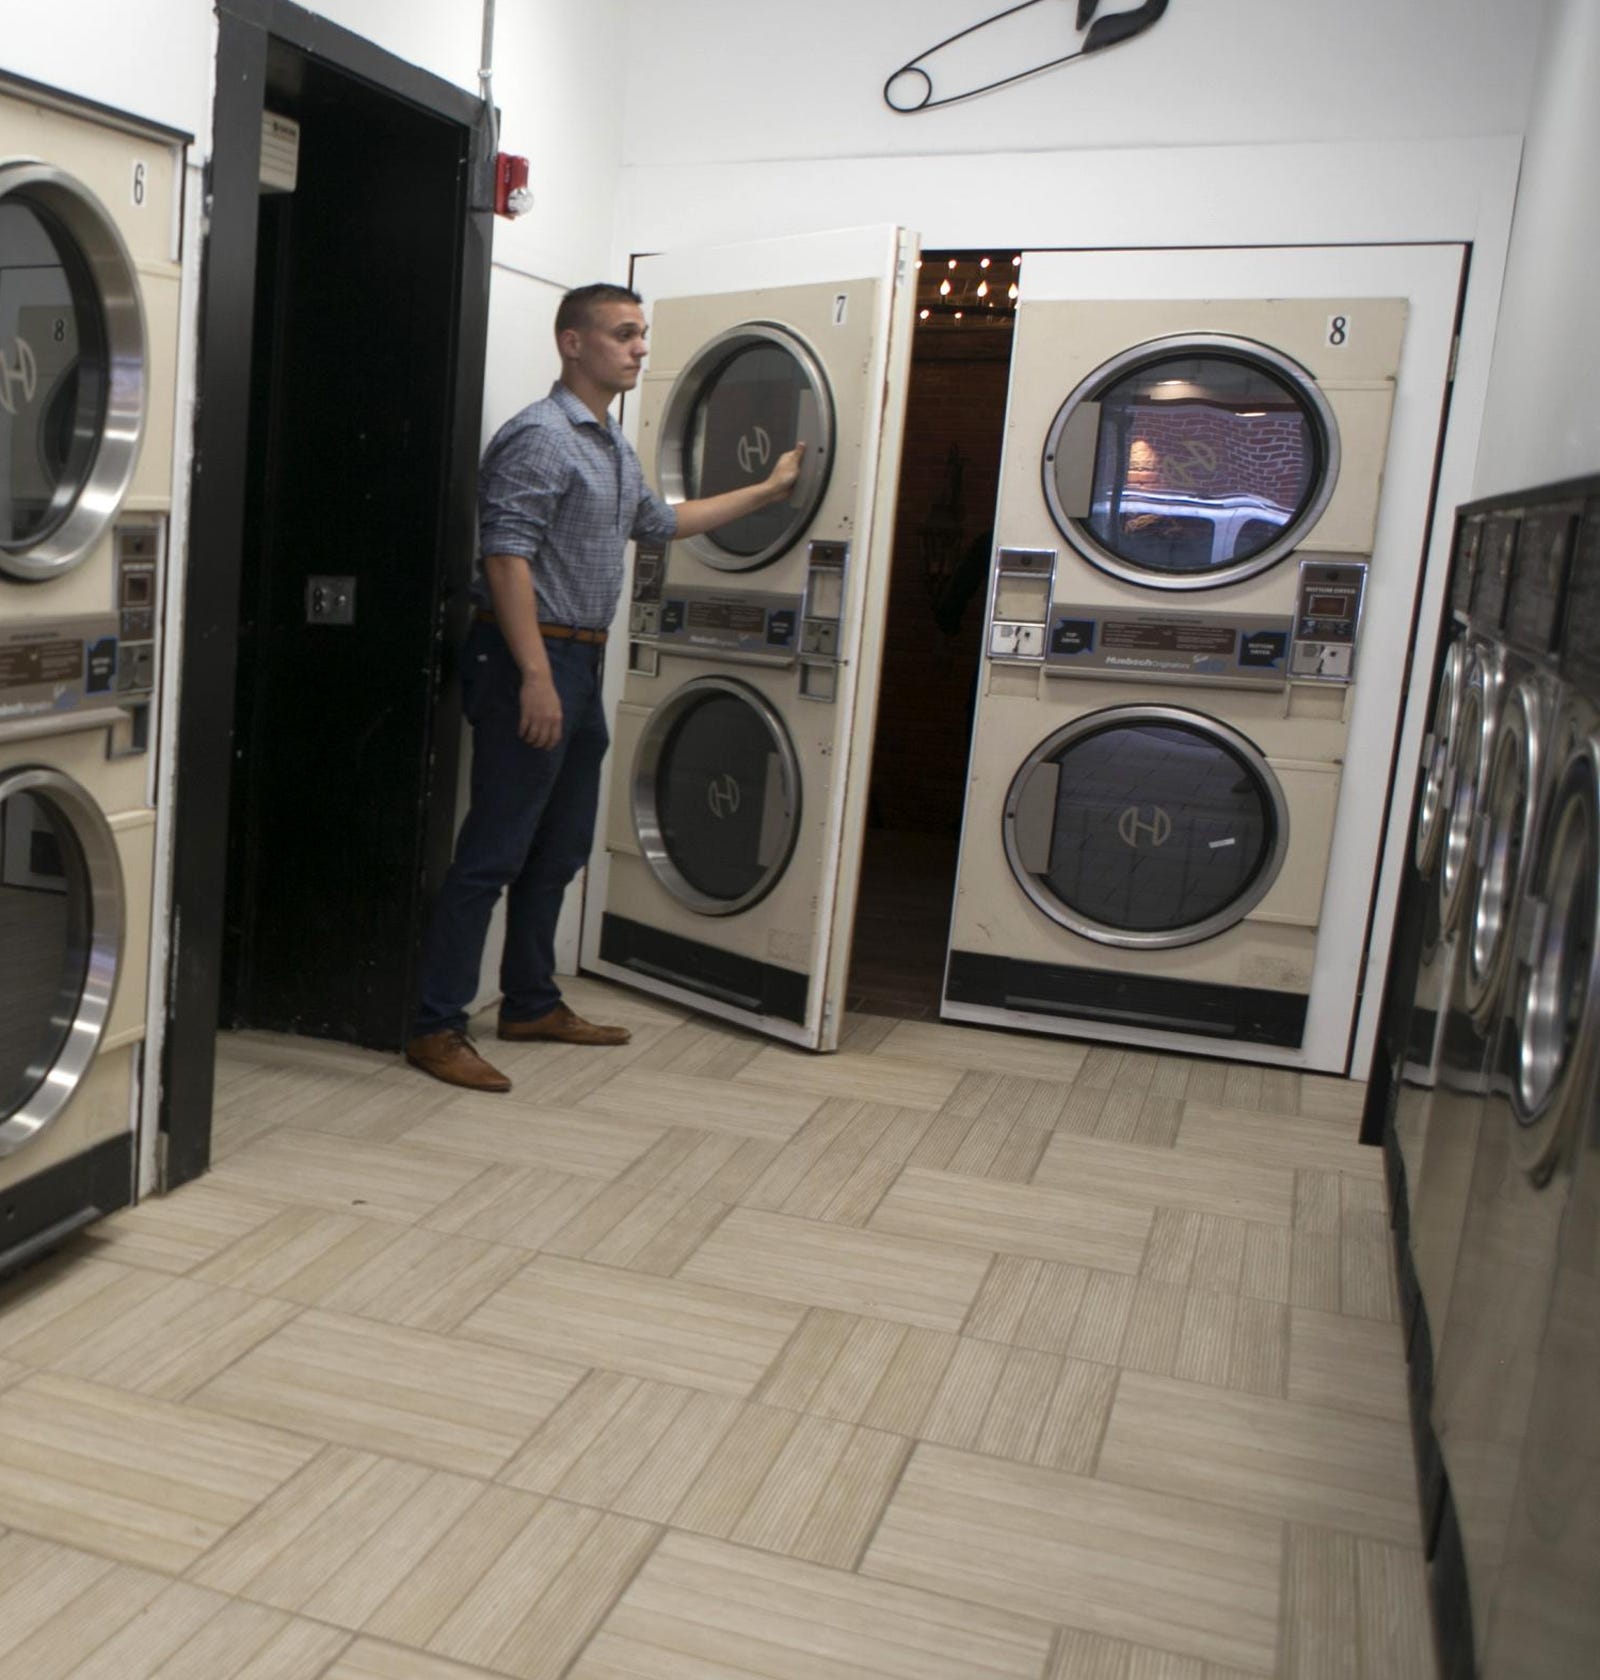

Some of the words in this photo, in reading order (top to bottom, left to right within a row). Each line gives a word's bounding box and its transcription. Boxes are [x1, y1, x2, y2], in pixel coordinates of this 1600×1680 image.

[134, 163, 144, 205] 6
[836, 295, 847, 324] 7
[1329, 316, 1346, 346] 8
